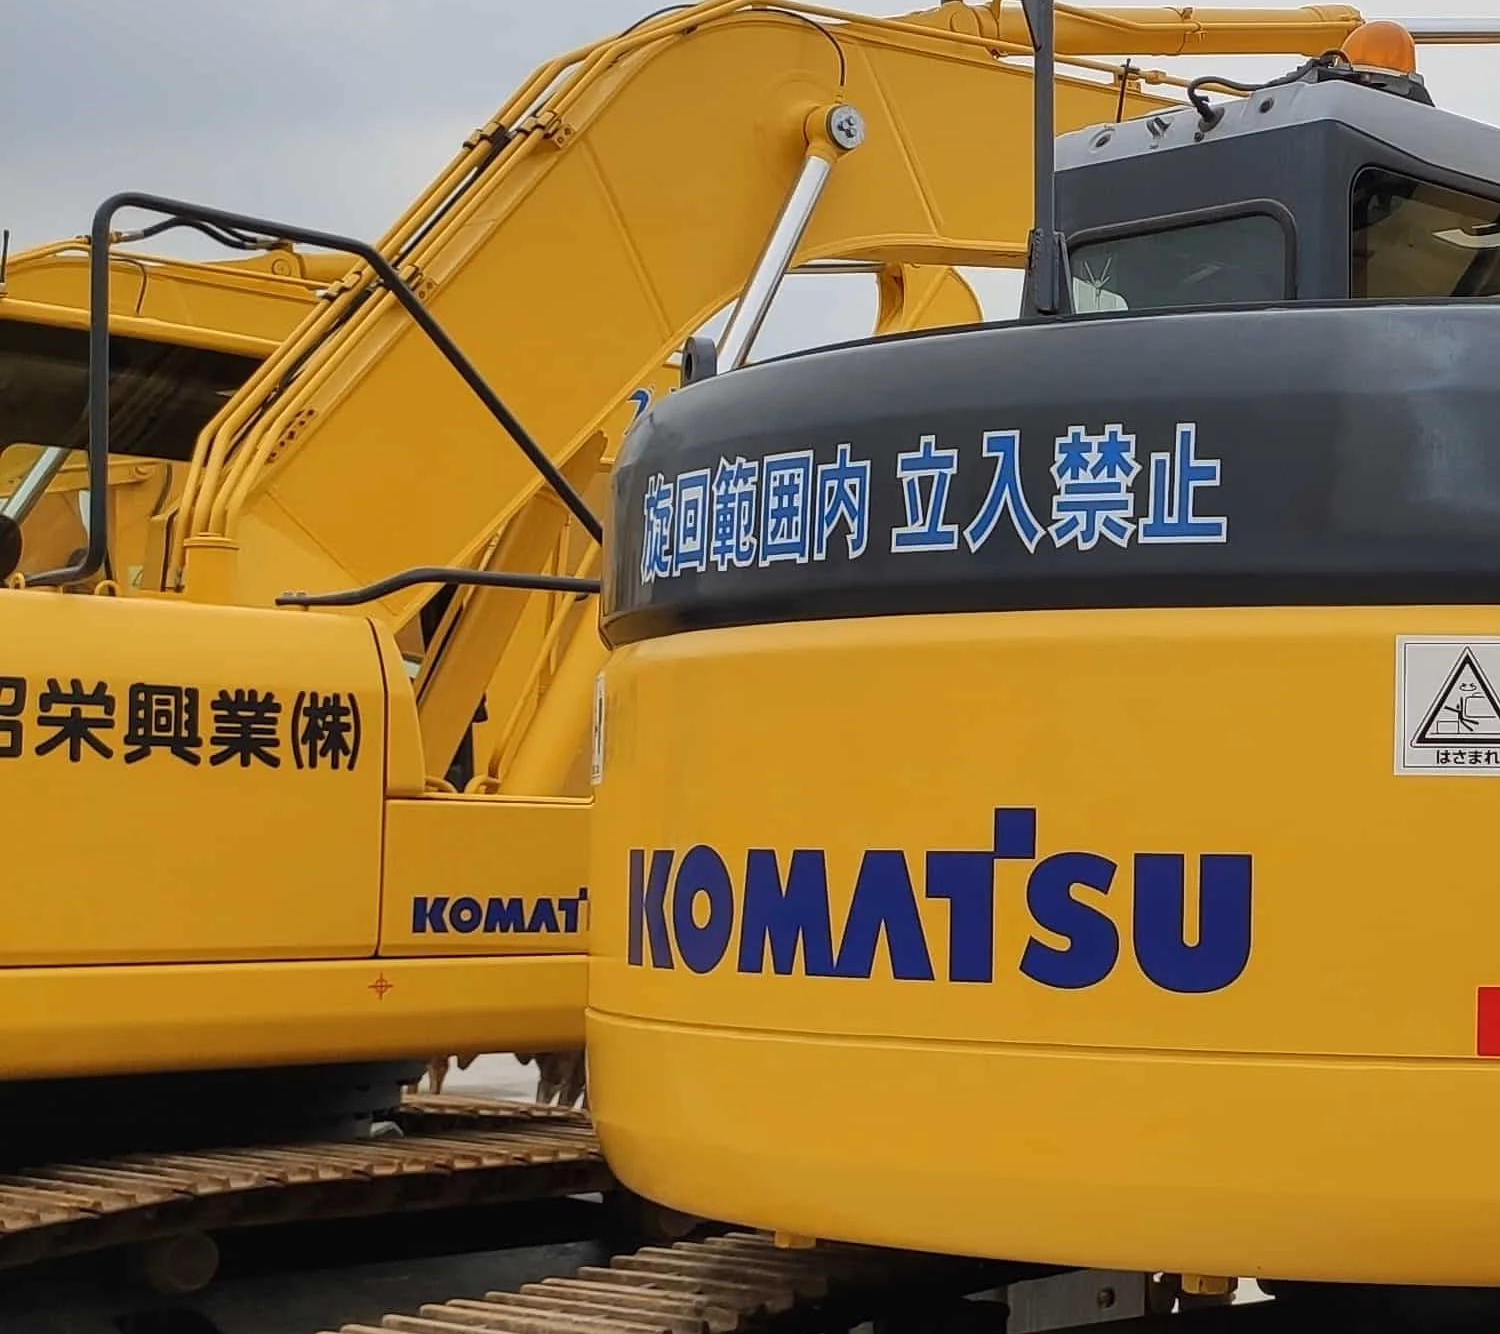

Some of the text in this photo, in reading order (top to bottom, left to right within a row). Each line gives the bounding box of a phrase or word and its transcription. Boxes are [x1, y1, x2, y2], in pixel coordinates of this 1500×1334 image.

[641, 422, 1228, 585] 旋回範囲内 立入禁止
[1435, 749, 1500, 766] はさまれ
[412, 887, 591, 934] KOMAT
[628, 807, 1253, 994] KOMATSU
